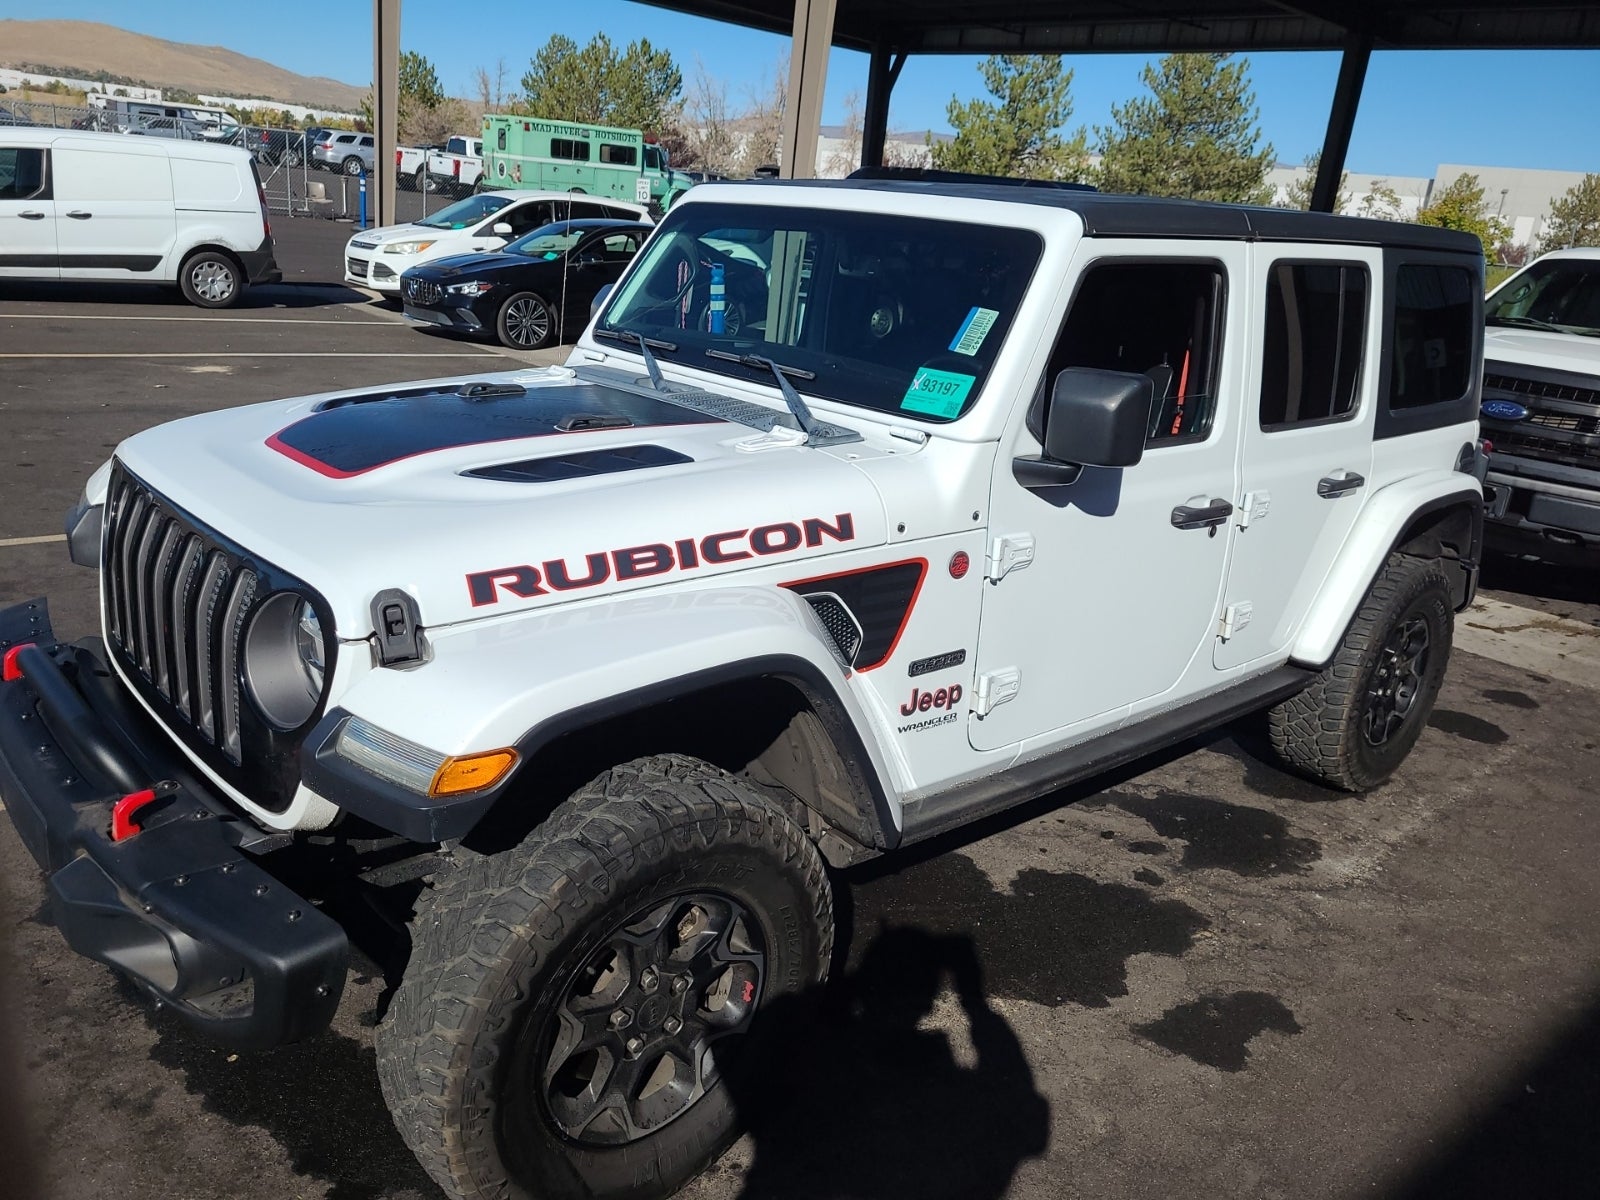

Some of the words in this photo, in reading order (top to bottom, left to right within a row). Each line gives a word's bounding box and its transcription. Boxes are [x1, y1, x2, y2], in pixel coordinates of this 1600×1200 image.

[532, 123, 551, 133] MAD
[554, 125, 580, 136] RIVER
[595, 130, 637, 143] HOTSHOTS
[638, 191, 648, 200] 10
[921, 377, 960, 397] 93197
[1488, 404, 1516, 415] Ford
[465, 512, 855, 608] RUBICON
[901, 684, 963, 716] Jeep
[897, 713, 958, 733] WRANGLER
[916, 718, 958, 732] UNLIMITED
